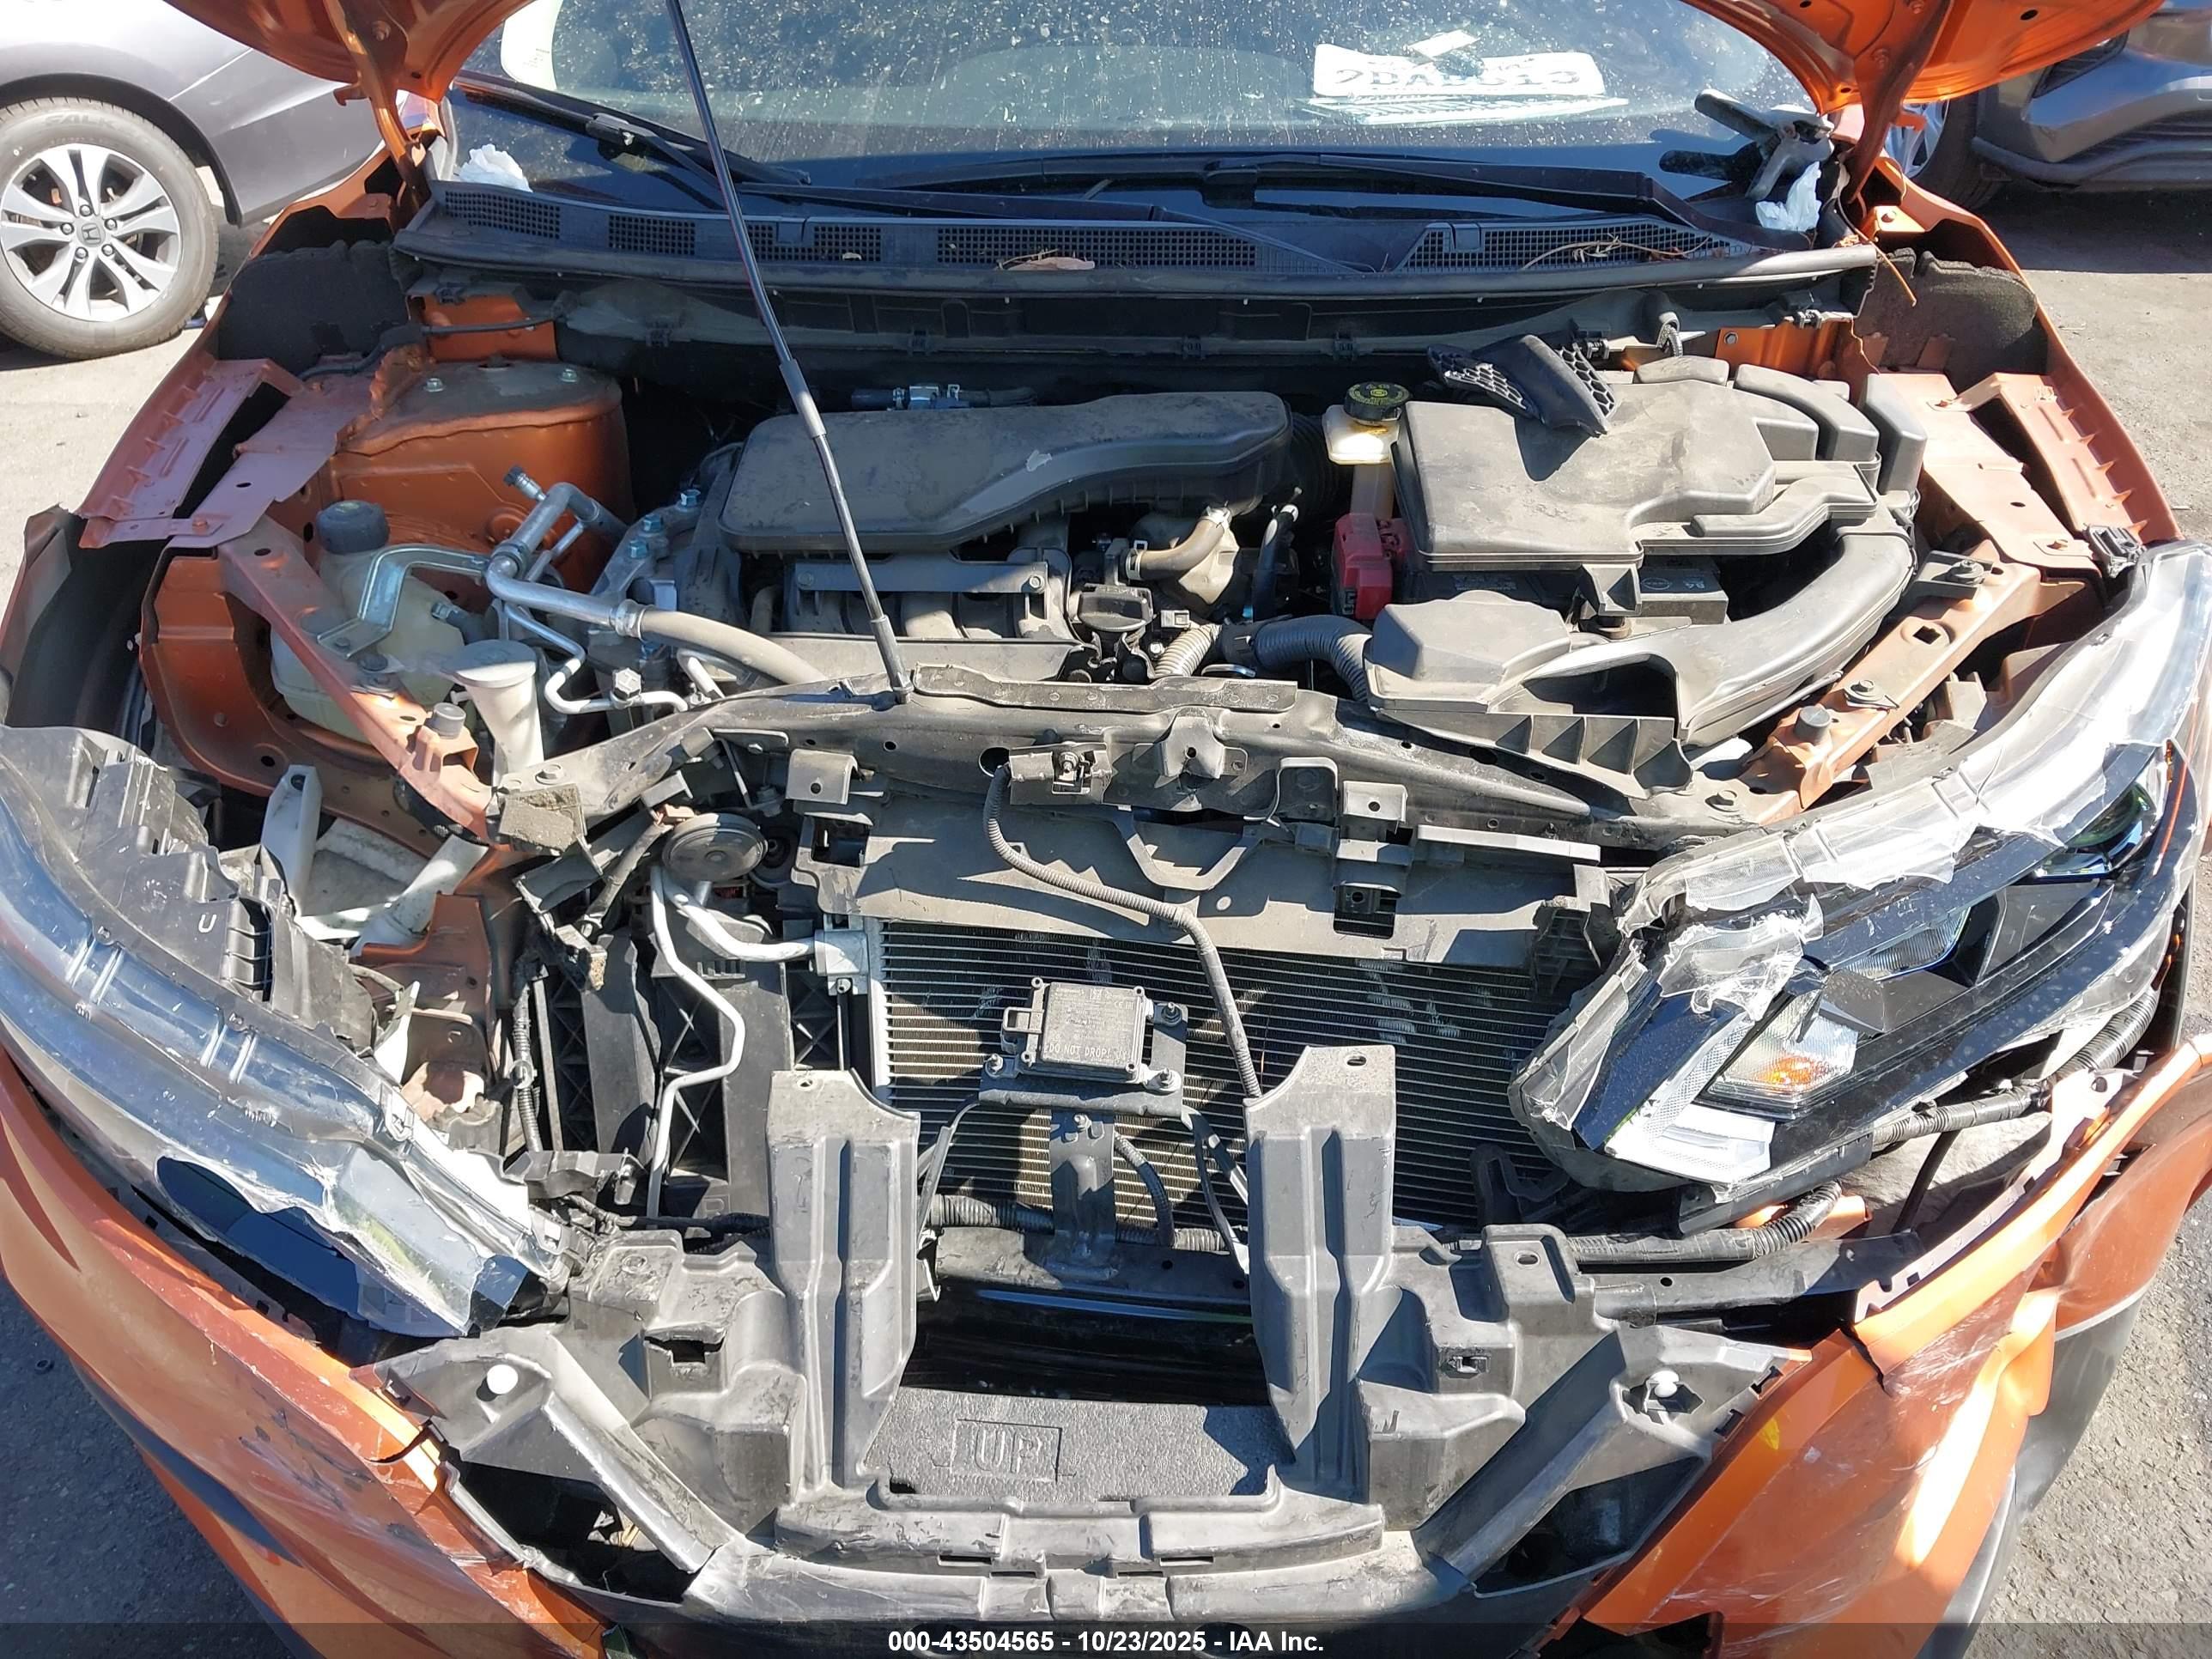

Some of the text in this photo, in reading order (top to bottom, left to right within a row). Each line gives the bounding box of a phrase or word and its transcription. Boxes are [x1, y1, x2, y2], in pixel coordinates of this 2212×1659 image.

[1048, 1043, 1061, 1053] DO
[1064, 1044, 1082, 1055] NOT
[1084, 1046, 1111, 1058] DROP!
[974, 1428, 1042, 1474] UP
